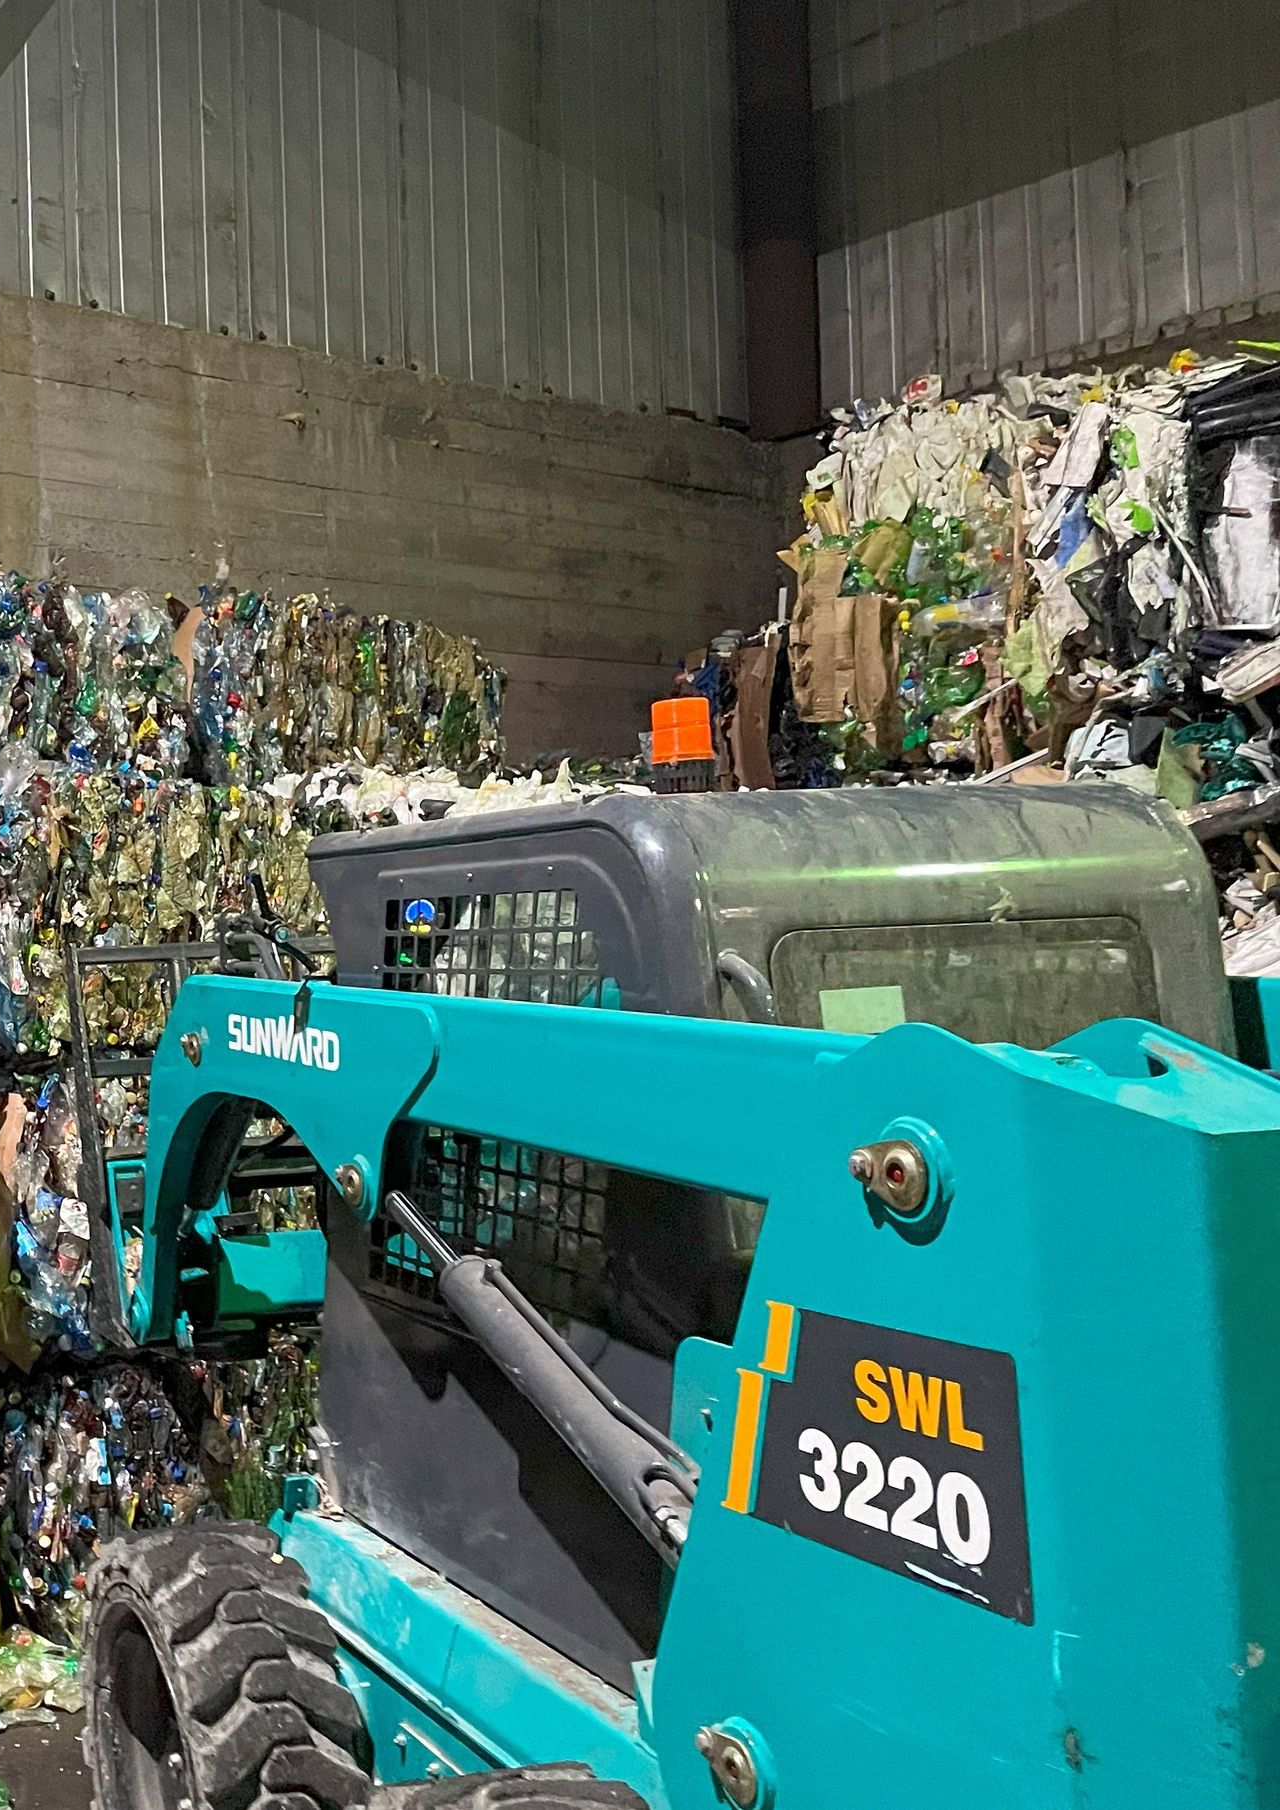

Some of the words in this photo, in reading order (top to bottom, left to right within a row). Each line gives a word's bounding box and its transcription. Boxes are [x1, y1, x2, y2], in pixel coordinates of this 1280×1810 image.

[228, 1013, 340, 1072] SUNWARD
[854, 1359, 984, 1451] SWL
[798, 1428, 991, 1566] 3220
